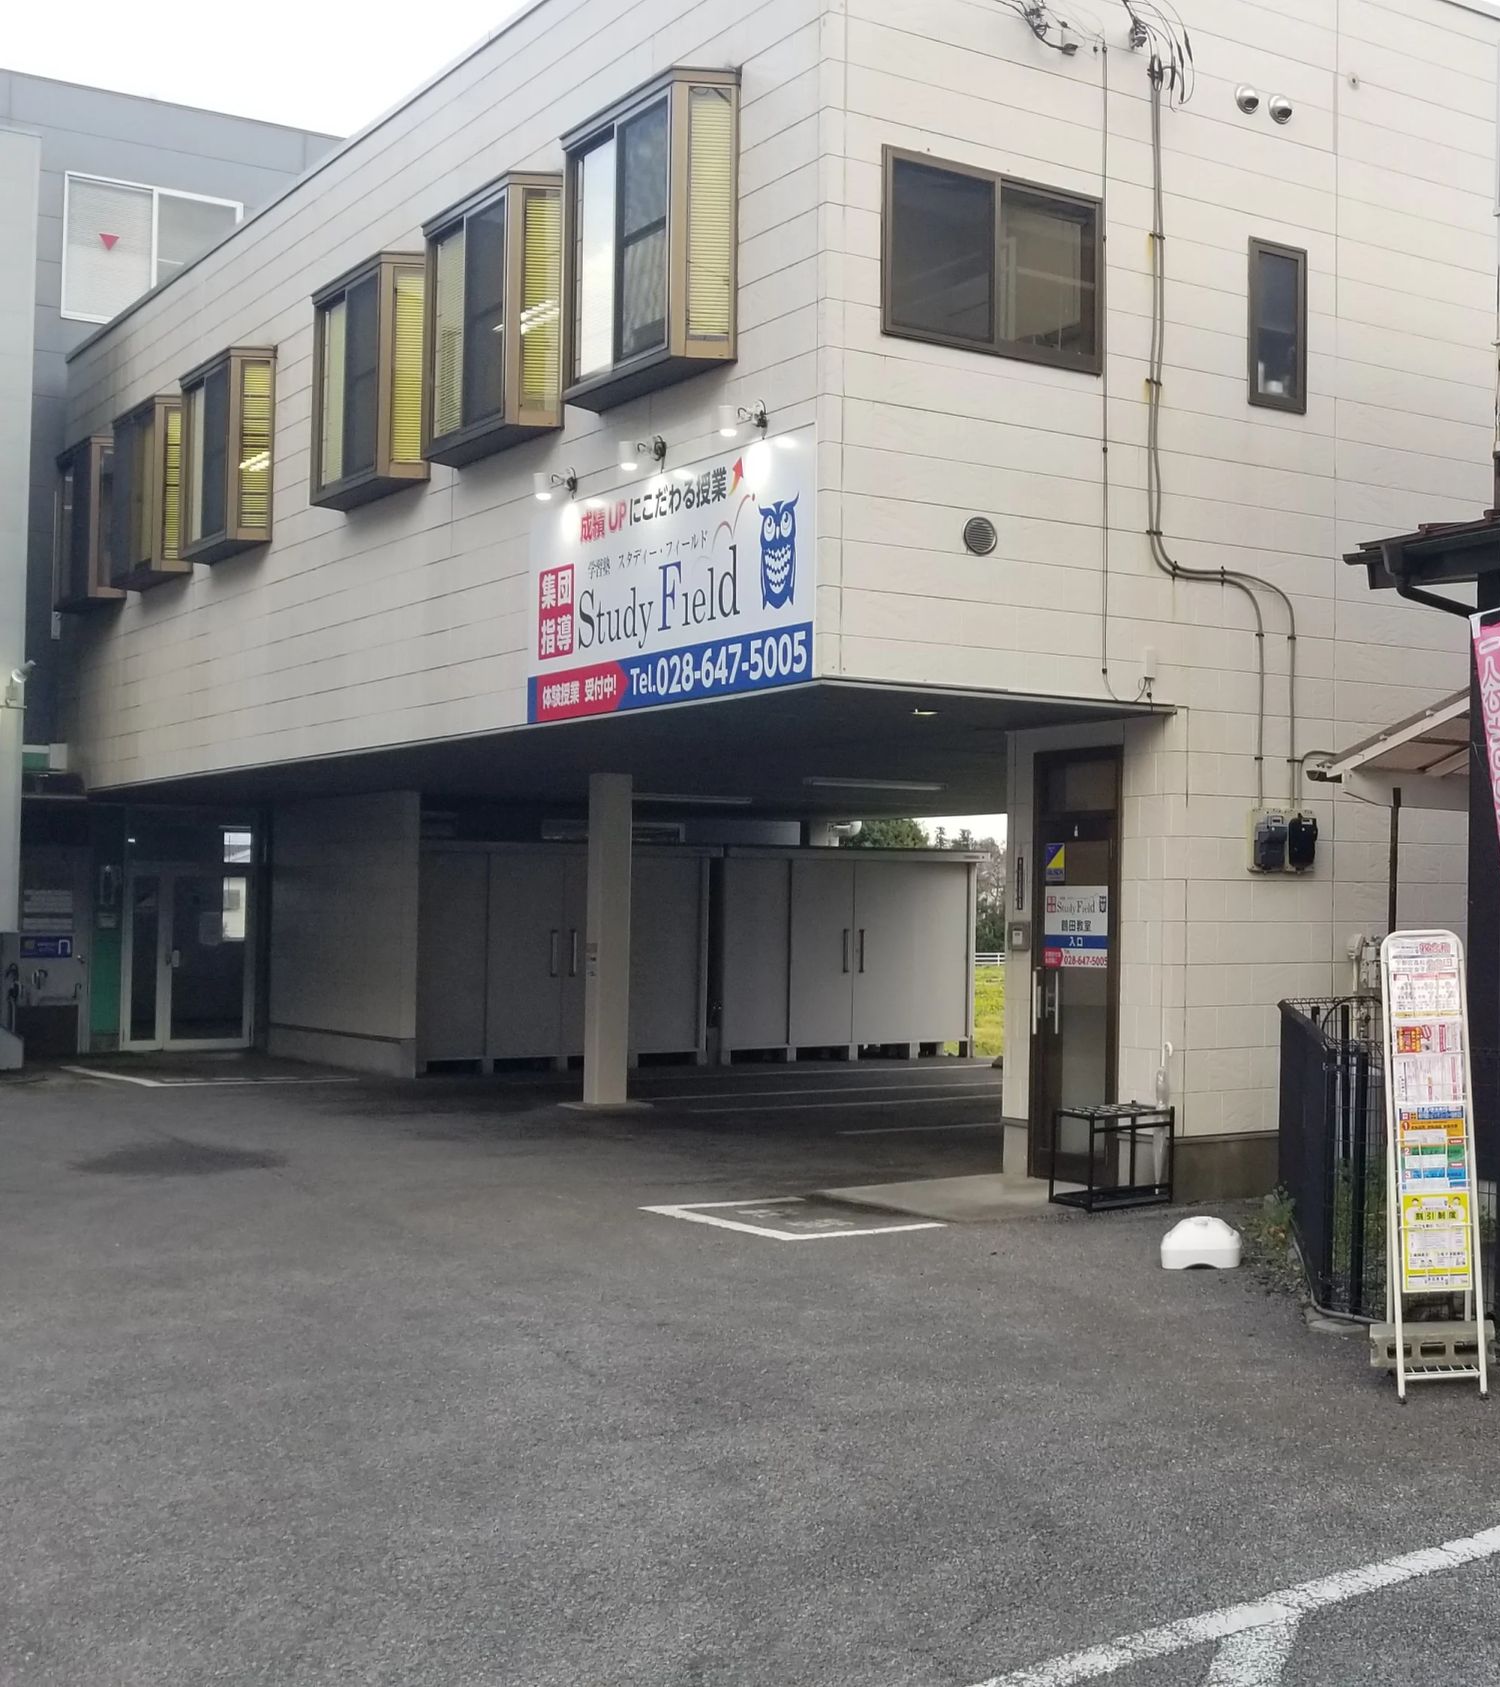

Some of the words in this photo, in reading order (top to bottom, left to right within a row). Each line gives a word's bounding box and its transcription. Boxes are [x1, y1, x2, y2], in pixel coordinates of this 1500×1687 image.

[541, 569, 572, 608] 集団
[578, 589, 654, 649] Study
[657, 545, 741, 632] Field
[541, 614, 572, 654] 指導
[543, 681, 579, 710] 体験授業
[1069, 936, 1083, 947] 入口
